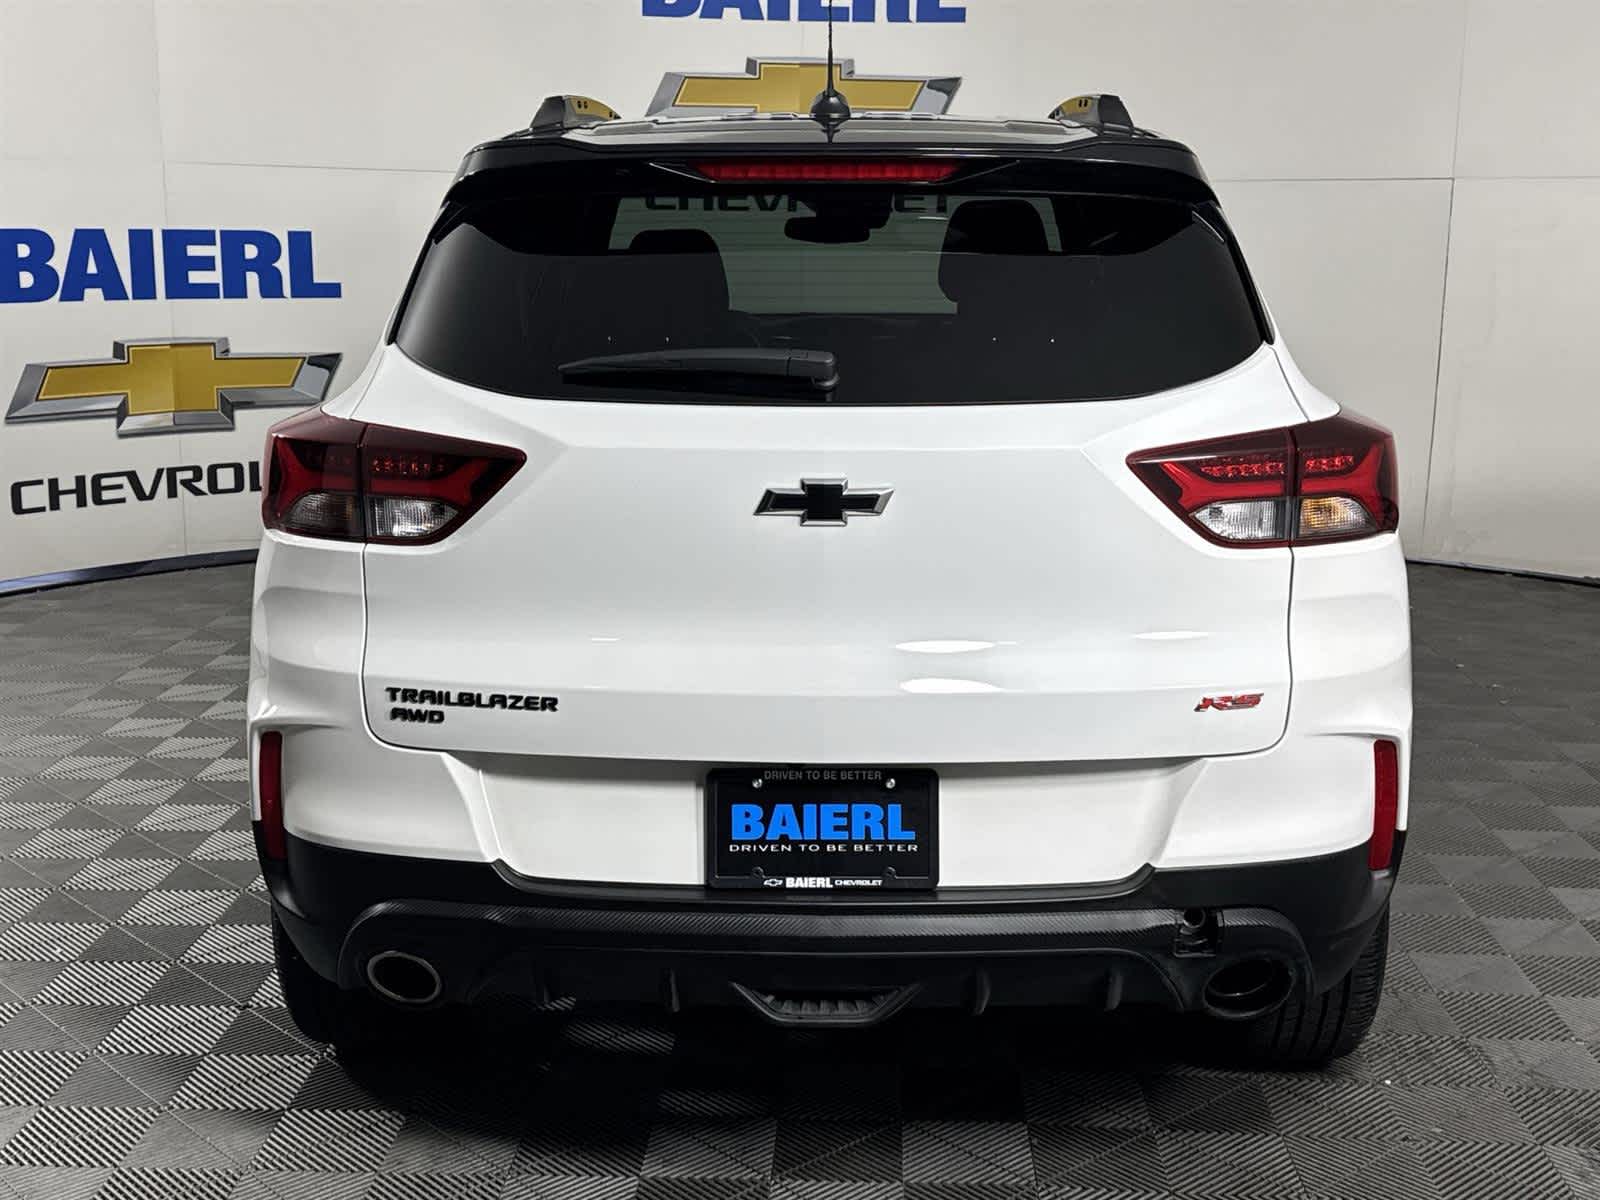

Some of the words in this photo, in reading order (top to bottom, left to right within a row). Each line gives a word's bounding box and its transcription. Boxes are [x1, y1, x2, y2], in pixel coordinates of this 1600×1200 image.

[0, 228, 342, 303] BAIERL
[10, 461, 262, 515] CHEVROL
[385, 687, 559, 712] TRAILBLAZER
[1194, 693, 1264, 712] RS
[390, 707, 445, 724] AWD
[764, 770, 802, 780] DRIVEN
[806, 770, 820, 780] TO
[823, 770, 837, 780] BE
[841, 770, 882, 780] BETTER
[731, 803, 916, 841] BAIERL
[729, 844, 792, 852] DRIVEN
[799, 844, 820, 852] TO
[826, 844, 848, 852] BE
[853, 844, 918, 852] BETTER
[785, 877, 833, 888] BAIERL
[834, 879, 883, 887] CHEVROLET
